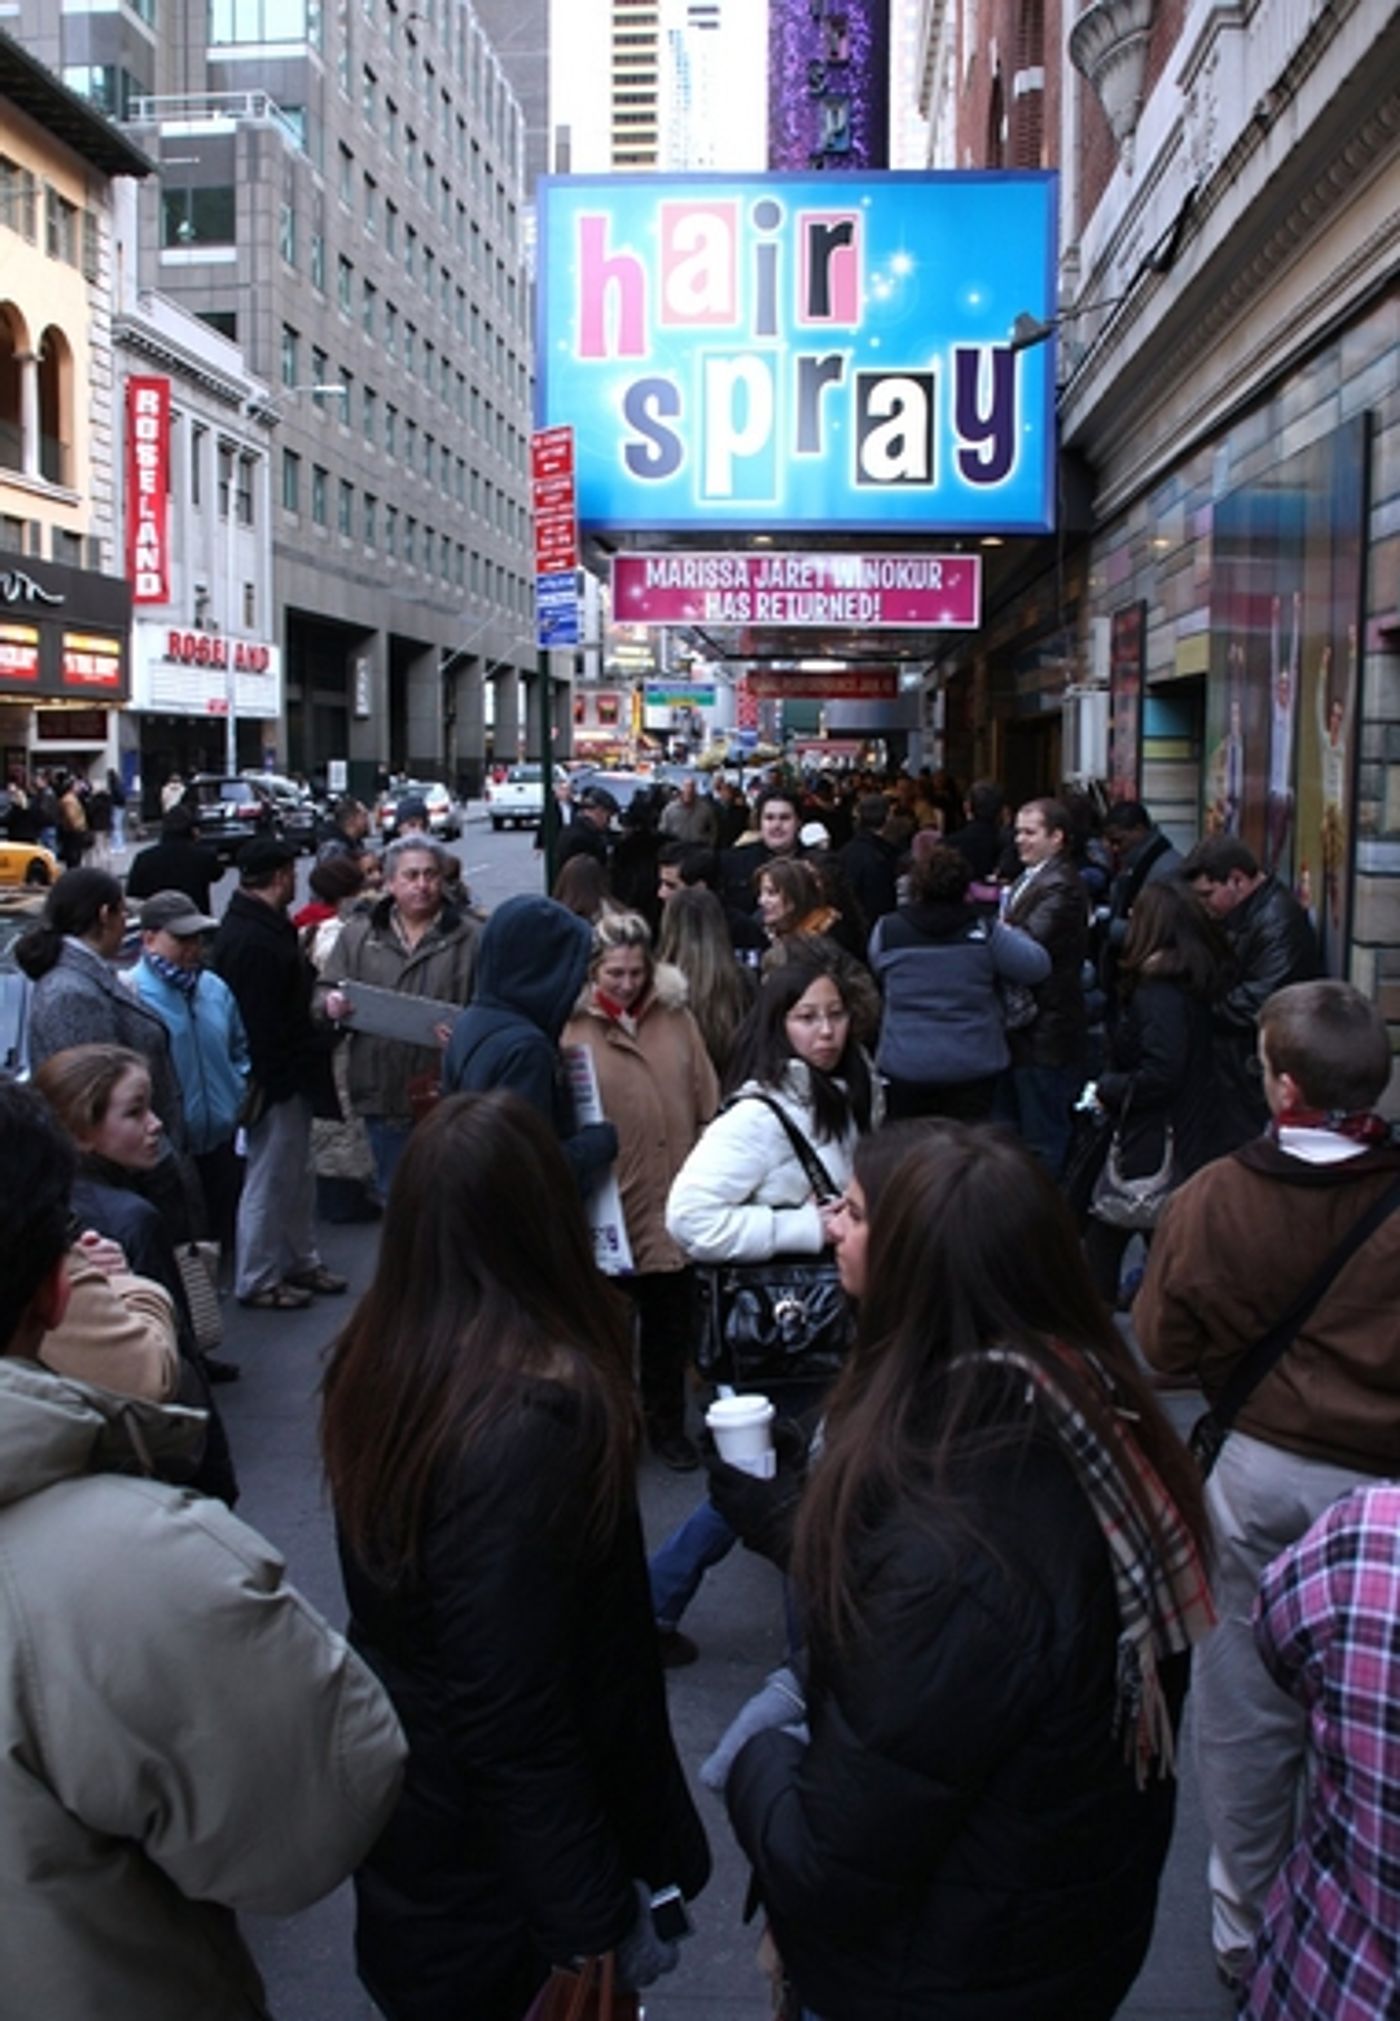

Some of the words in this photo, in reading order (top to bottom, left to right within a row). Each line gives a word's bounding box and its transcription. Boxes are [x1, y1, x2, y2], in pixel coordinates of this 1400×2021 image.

[579, 199, 858, 357] hair
[135, 388, 161, 597] ROSELAND
[623, 347, 1018, 499] spray
[646, 559, 748, 589] MARISSA
[755, 559, 827, 589] JARET
[831, 560, 942, 590] WINOKUR
[705, 592, 749, 620] HAS
[756, 592, 881, 621] RETURNED!
